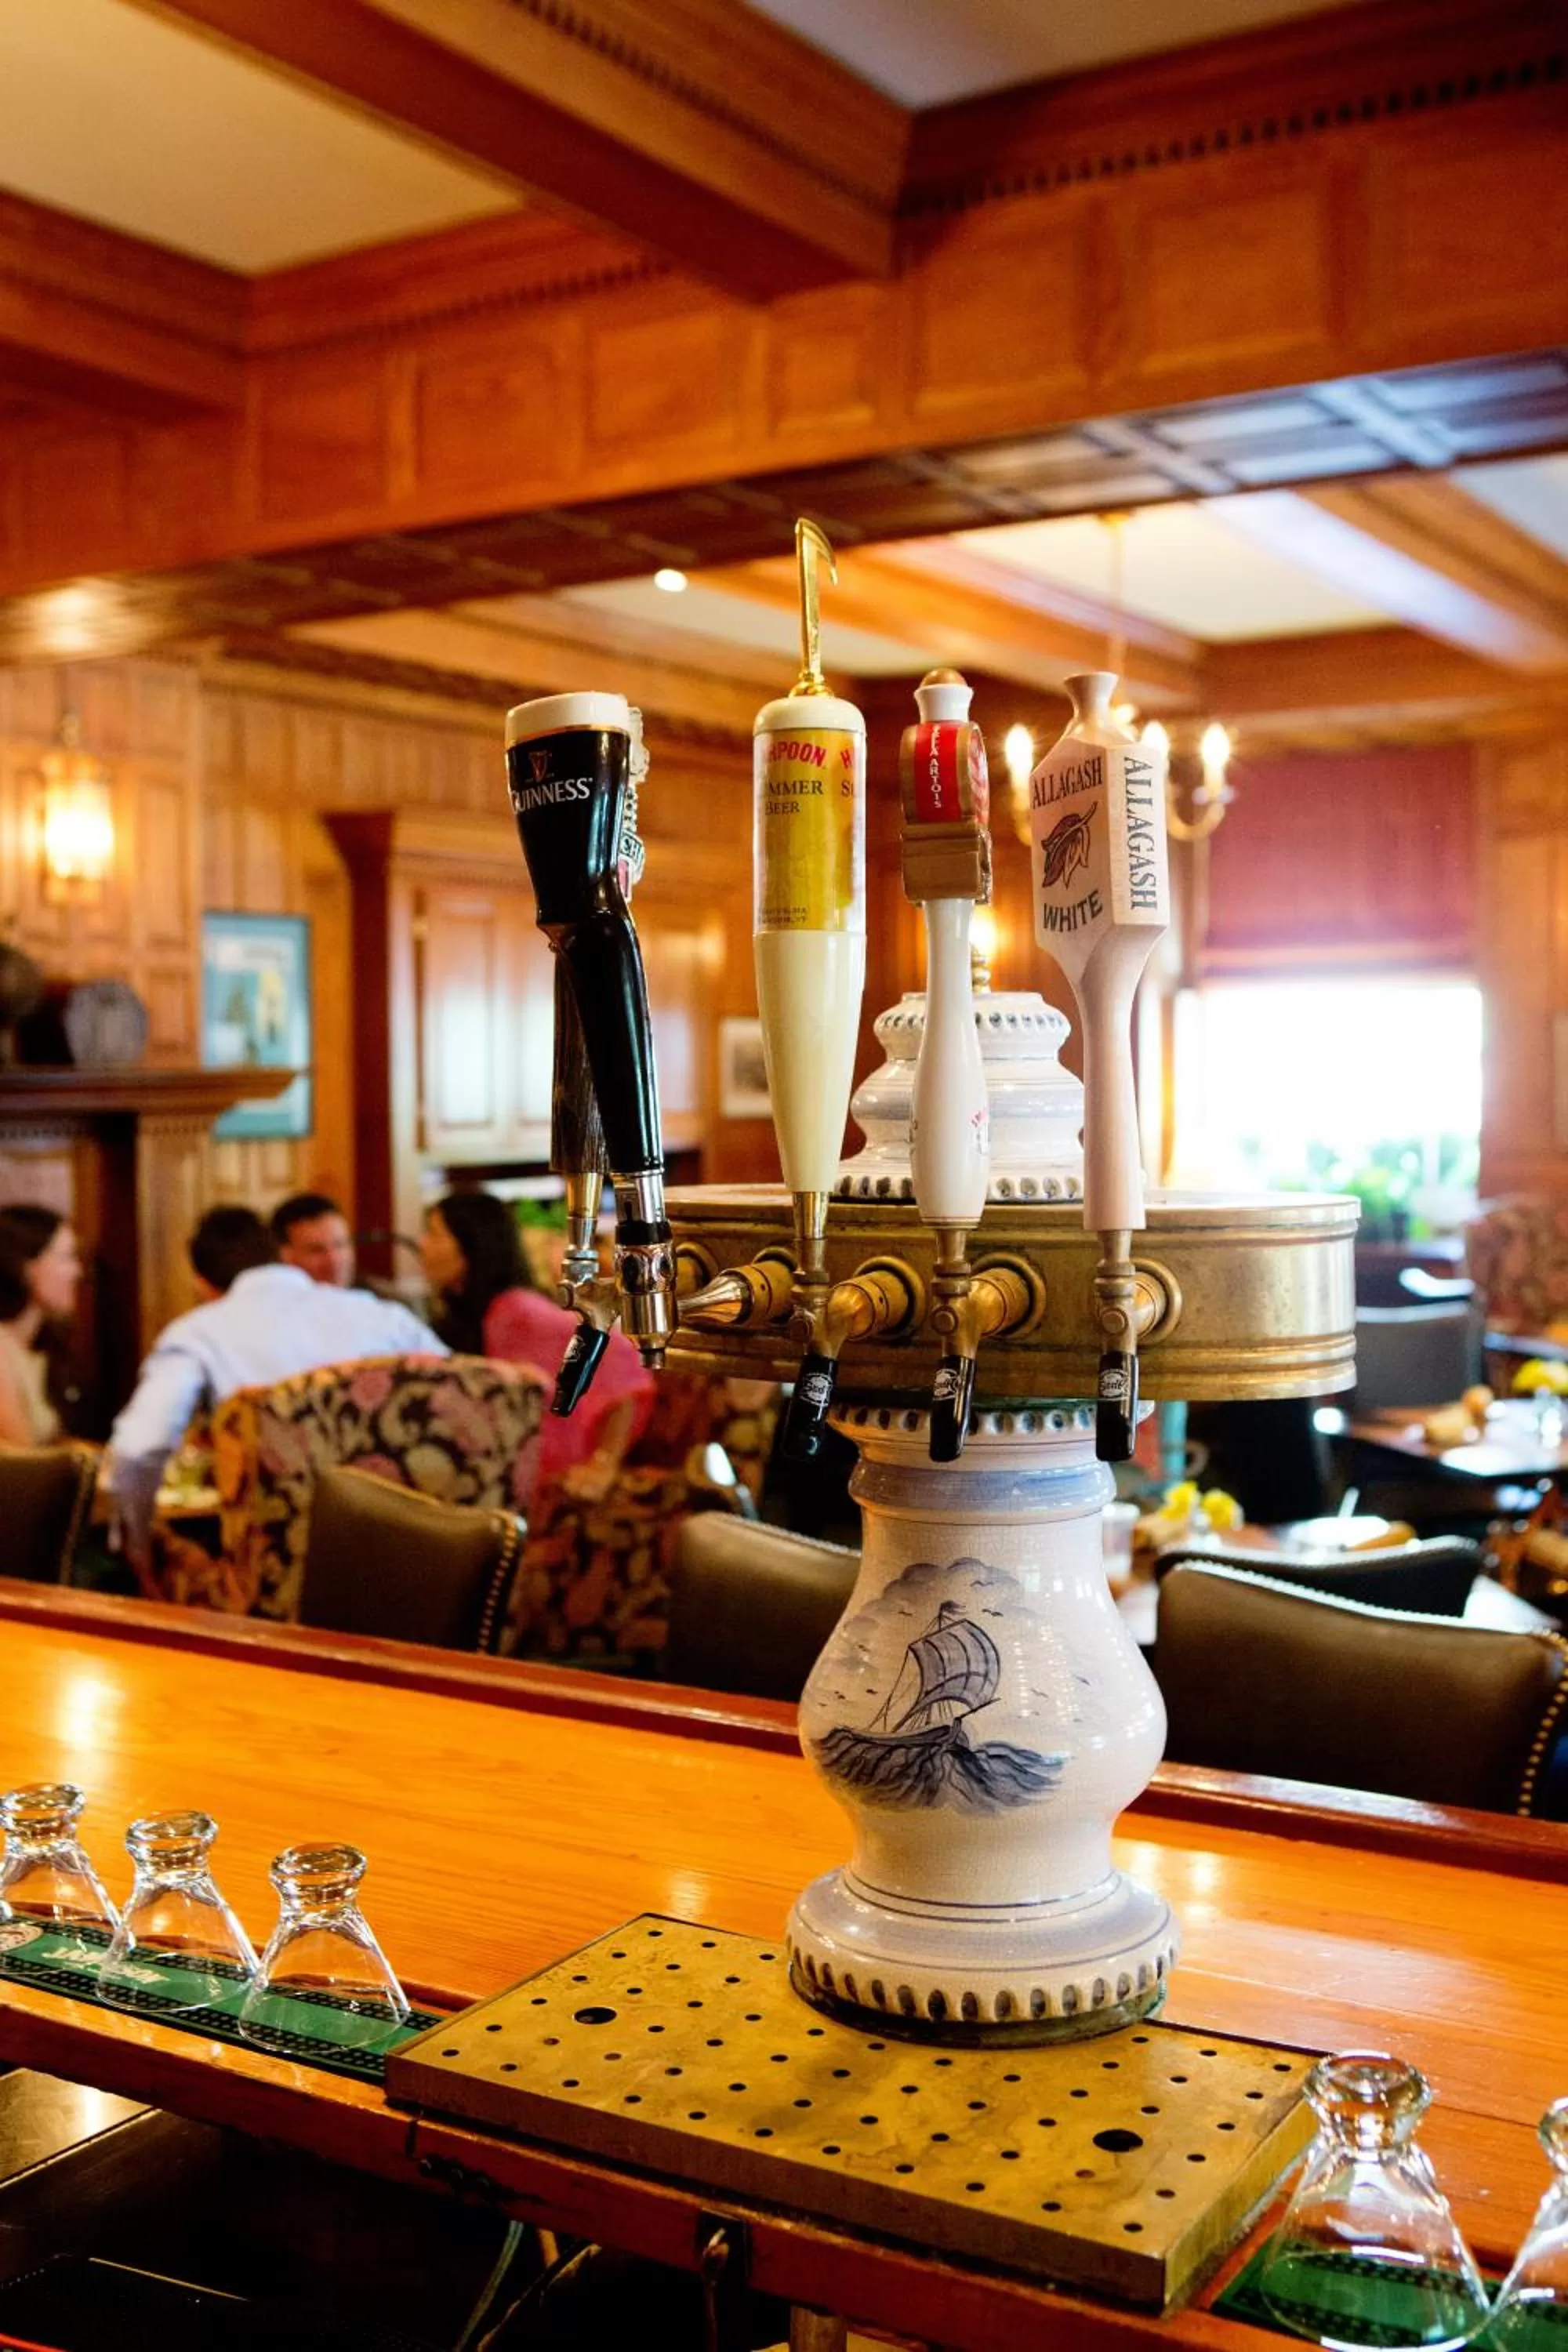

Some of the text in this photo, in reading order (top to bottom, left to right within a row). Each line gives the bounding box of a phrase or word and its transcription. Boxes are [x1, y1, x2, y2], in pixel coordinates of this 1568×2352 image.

[510, 777, 590, 815] GUINNESS
[929, 757, 942, 808] ARTOIS
[1032, 755, 1103, 809] ALLAGASH
[1123, 756, 1159, 911] ALLAGASH
[1042, 890, 1103, 933] WHITE
